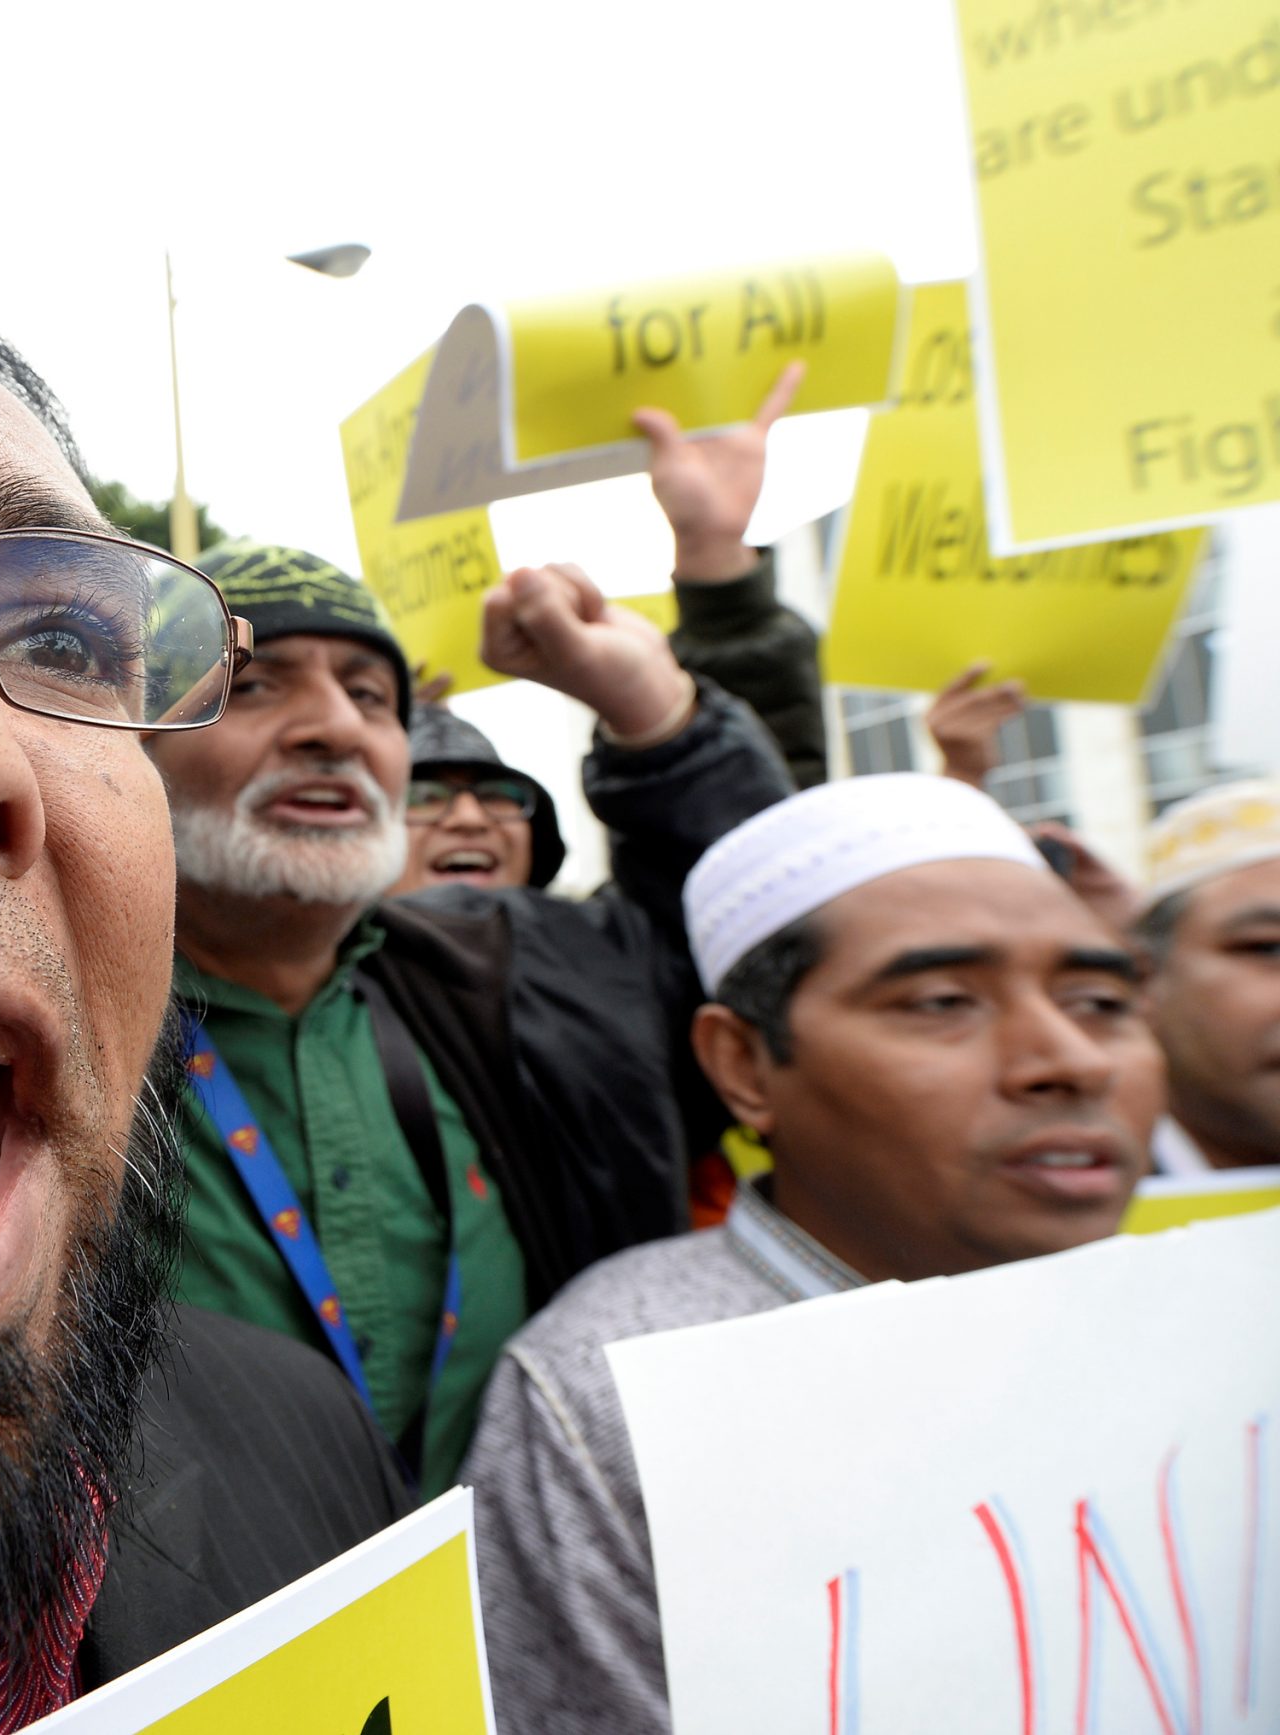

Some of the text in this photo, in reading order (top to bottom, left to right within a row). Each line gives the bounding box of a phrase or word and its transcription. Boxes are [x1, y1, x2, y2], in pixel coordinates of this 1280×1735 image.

[972, 0, 1194, 70] whe
[974, 101, 1093, 181] are
[1130, 160, 1280, 251] Sta
[605, 268, 830, 376] for All
